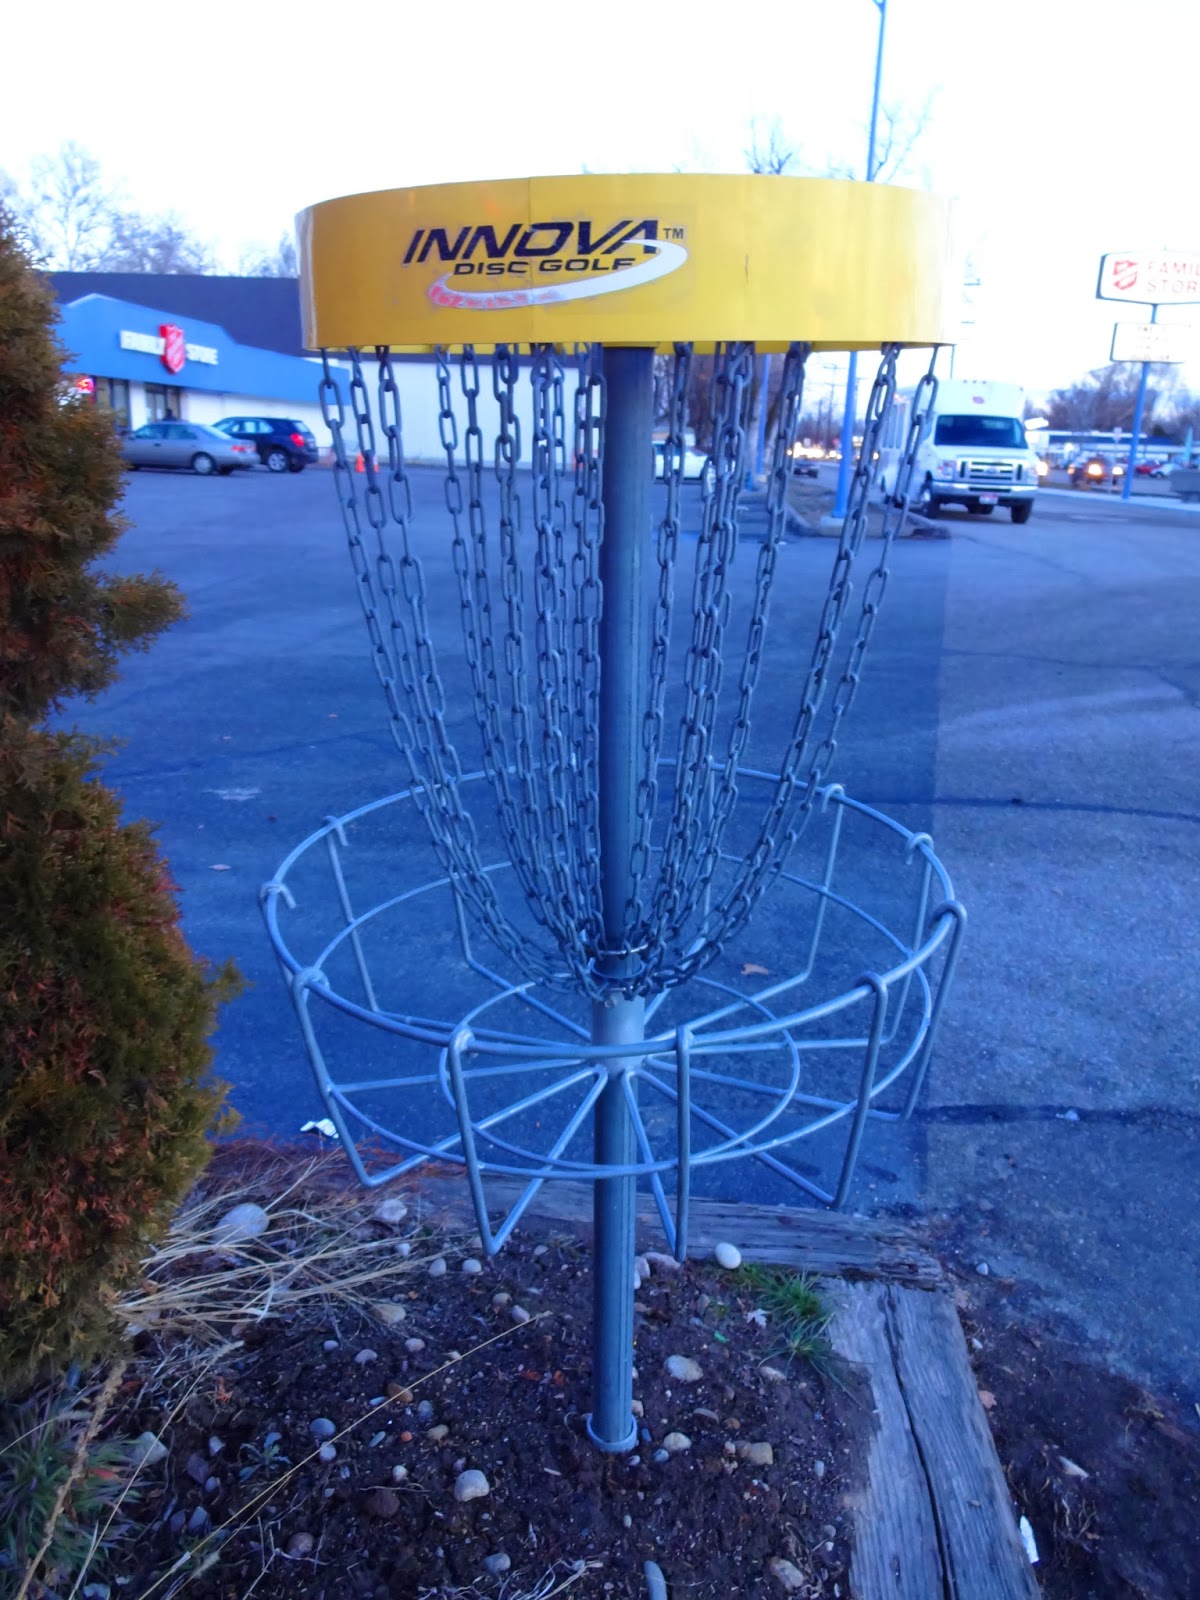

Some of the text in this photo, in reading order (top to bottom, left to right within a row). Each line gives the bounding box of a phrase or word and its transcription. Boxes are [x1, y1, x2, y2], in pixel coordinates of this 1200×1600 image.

[403, 219, 684, 265] INNOVA TM
[453, 257, 636, 276] DISC GOLF
